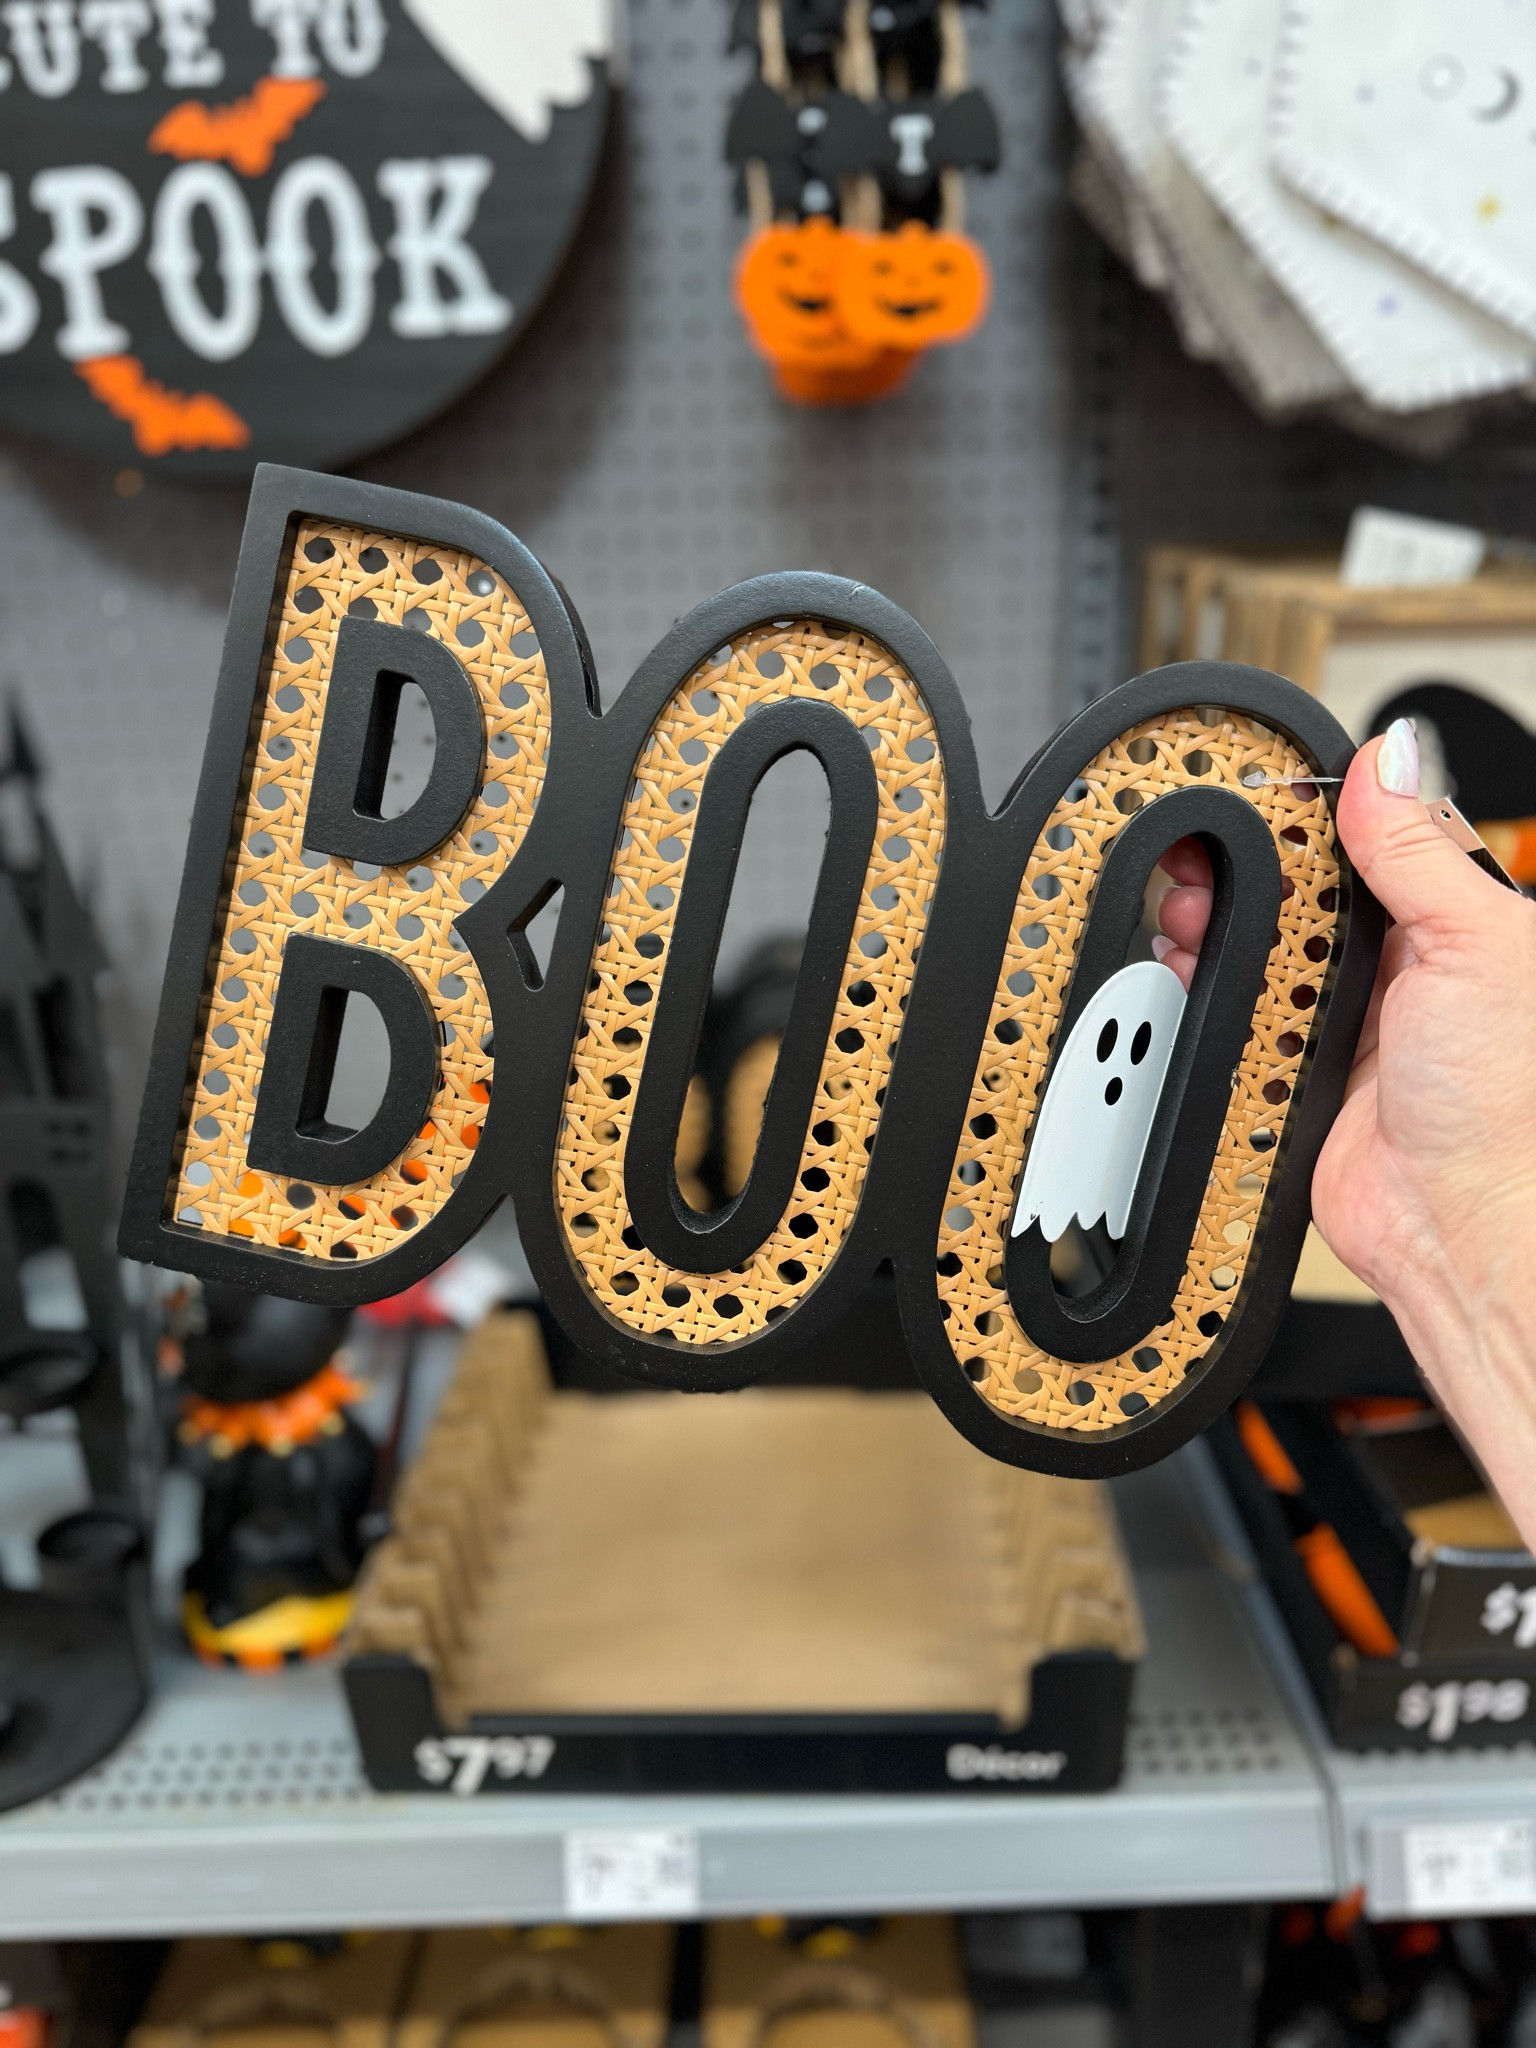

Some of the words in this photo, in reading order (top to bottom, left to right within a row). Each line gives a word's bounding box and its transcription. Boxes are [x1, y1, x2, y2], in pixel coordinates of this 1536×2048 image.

[0, 0, 224, 97] UTE
[252, 0, 386, 79] TO
[119, 462, 1390, 1481] BOO
